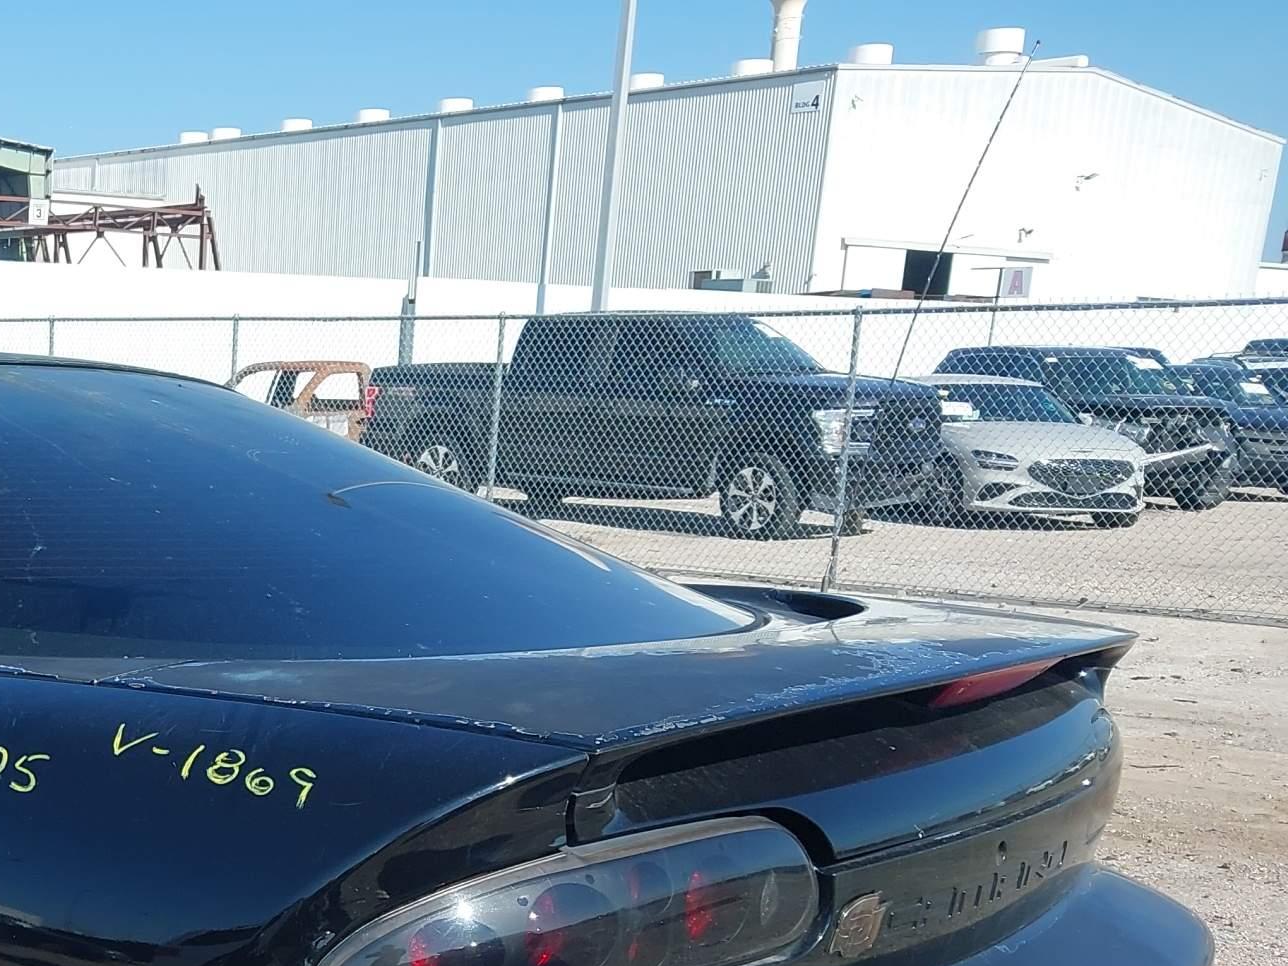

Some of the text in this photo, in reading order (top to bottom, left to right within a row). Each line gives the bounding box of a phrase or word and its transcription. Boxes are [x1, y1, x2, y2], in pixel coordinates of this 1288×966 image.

[811, 94, 820, 110] 4
[36, 208, 42, 218] 3
[1007, 270, 1023, 295] A
[113, 723, 316, 808] V-1869
